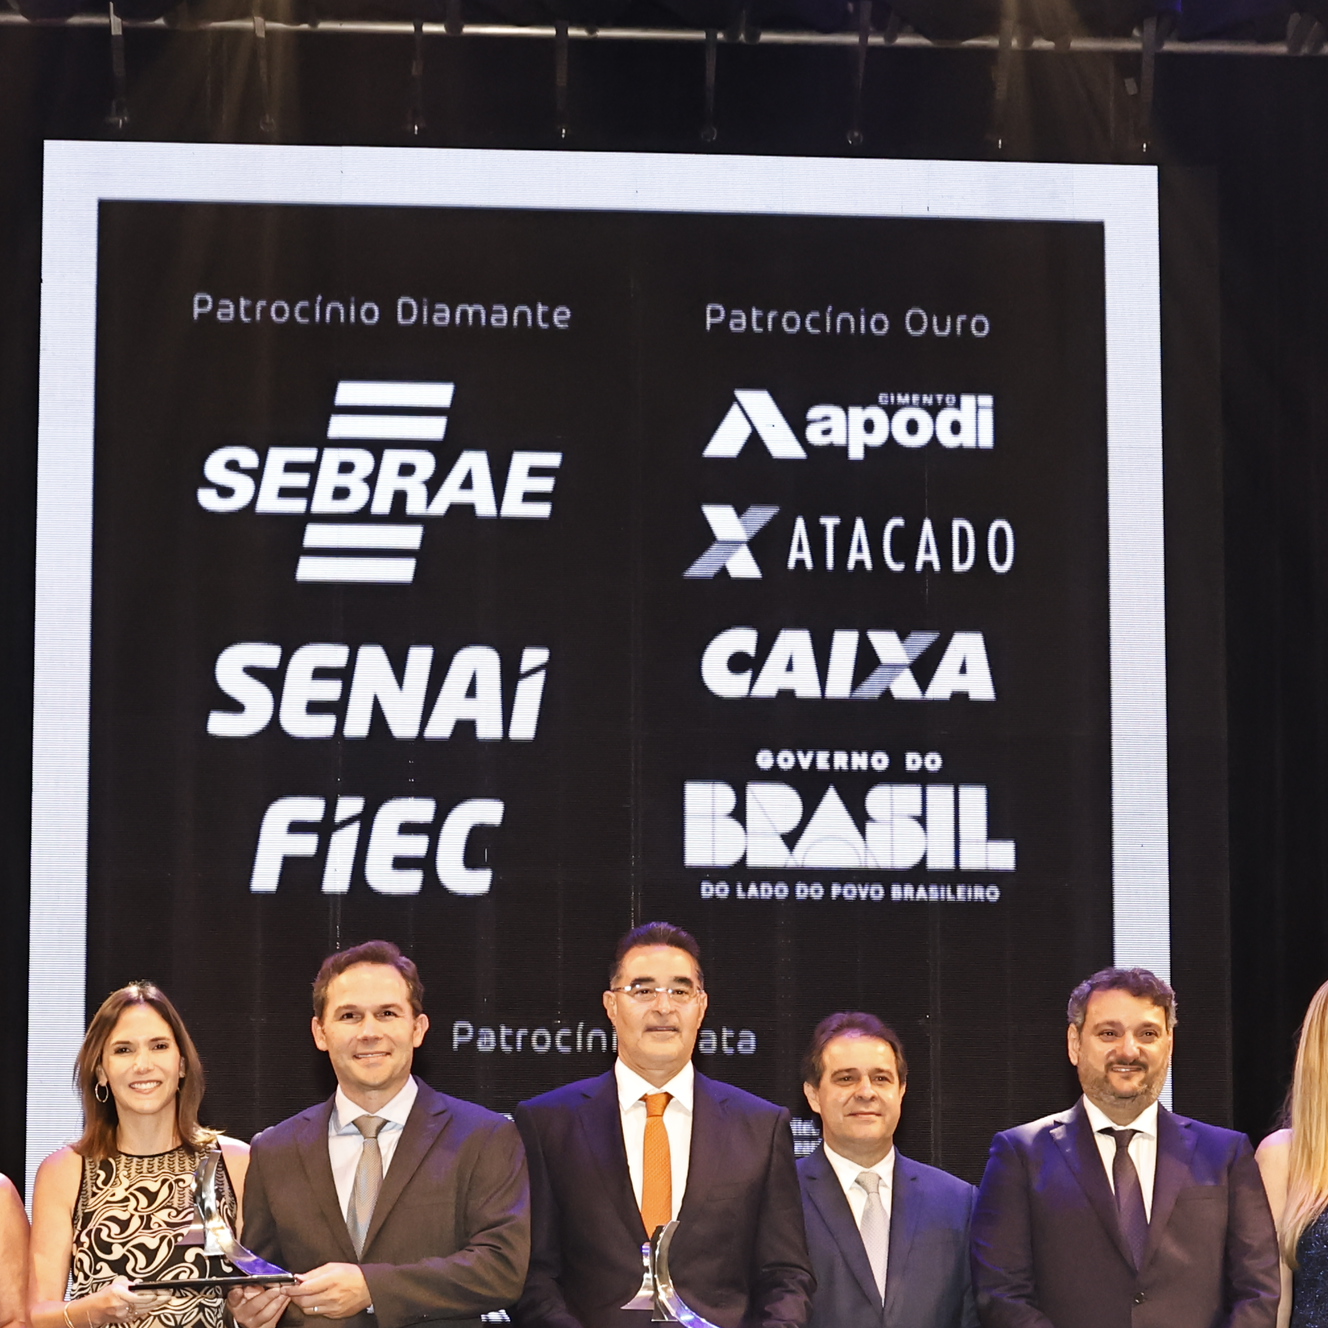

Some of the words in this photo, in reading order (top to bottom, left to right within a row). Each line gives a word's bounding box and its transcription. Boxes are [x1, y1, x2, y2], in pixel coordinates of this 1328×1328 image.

[192, 292, 380, 325] Patrocínio
[396, 296, 572, 329] Diamante
[705, 303, 890, 336] Patrocínio
[904, 307, 990, 338] Ouro
[877, 392, 957, 406] CIMENTO
[804, 392, 994, 461] apodi
[196, 445, 563, 518] SEBRAE
[787, 515, 1015, 574] ATACADO
[700, 627, 996, 702] CAIXA
[755, 749, 890, 771] GOVERNO
[905, 751, 943, 772] DO
[683, 781, 1016, 871] BRASIL
[700, 881, 730, 899] DO
[735, 882, 790, 900] LADO
[795, 881, 825, 900] DO
[830, 883, 885, 901] POVO
[890, 884, 1001, 902] BRASILEIRO
[451, 1020, 618, 1054] Patrocíni
[697, 1026, 758, 1055] ata
